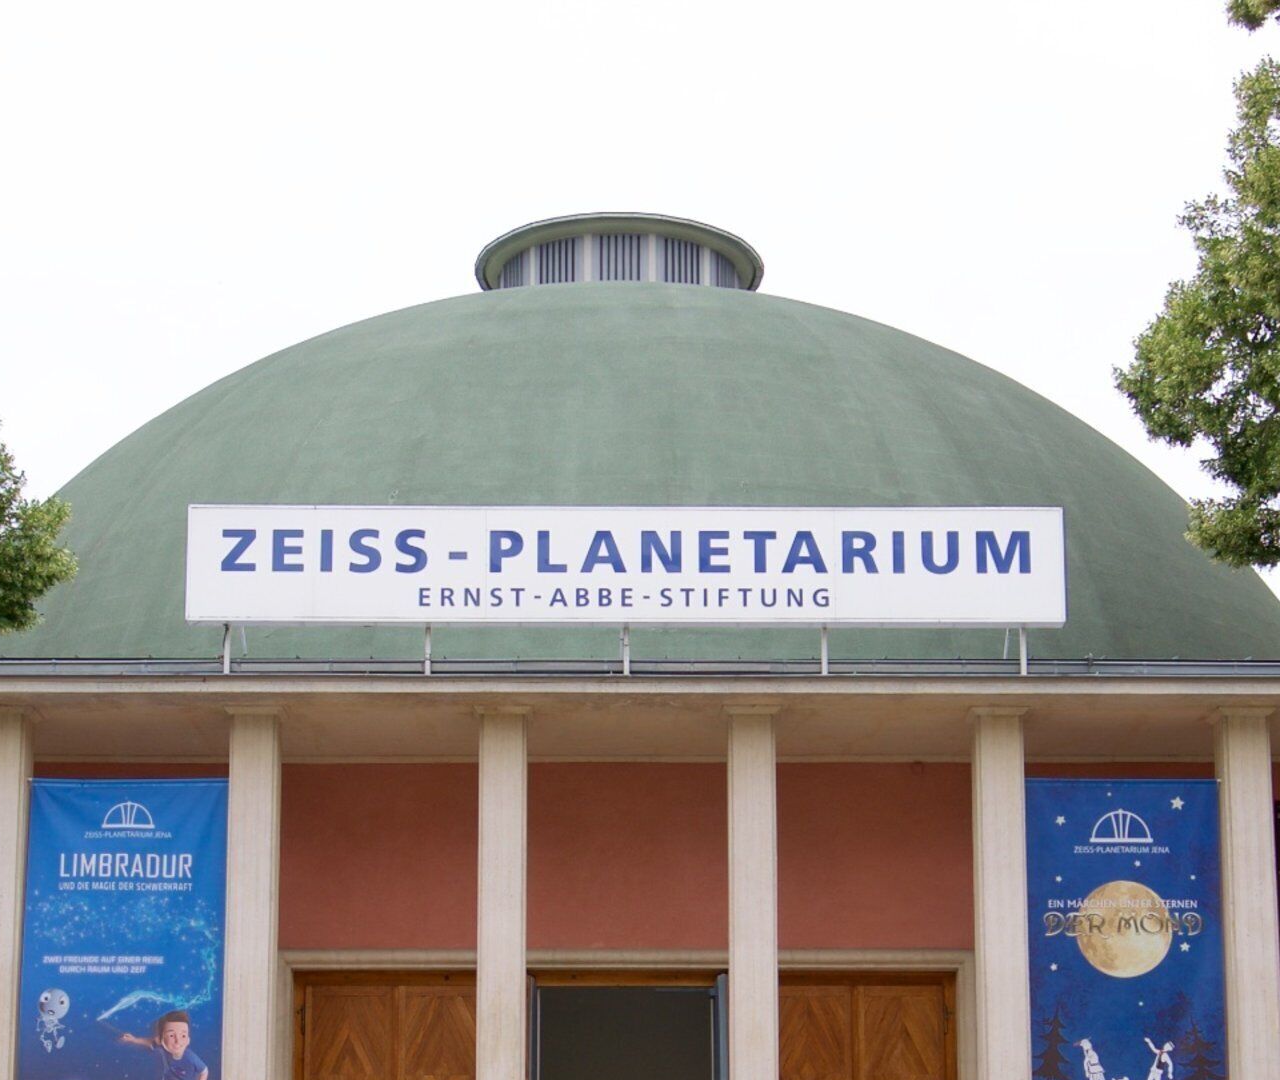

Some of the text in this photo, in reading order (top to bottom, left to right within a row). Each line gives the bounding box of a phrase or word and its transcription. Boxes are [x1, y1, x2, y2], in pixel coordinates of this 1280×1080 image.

[418, 587, 831, 608] ERNST-ABBE-STIFTUNG
[1073, 846, 1169, 854] ZEISS-PLANETARIUM JENA
[59, 853, 193, 879] LIMBRADUR
[59, 882, 192, 892] UND DIE MAGIE DER SCHWERKRAFT
[1048, 900, 1064, 909] EIN
[1155, 899, 1198, 909] STERNEN
